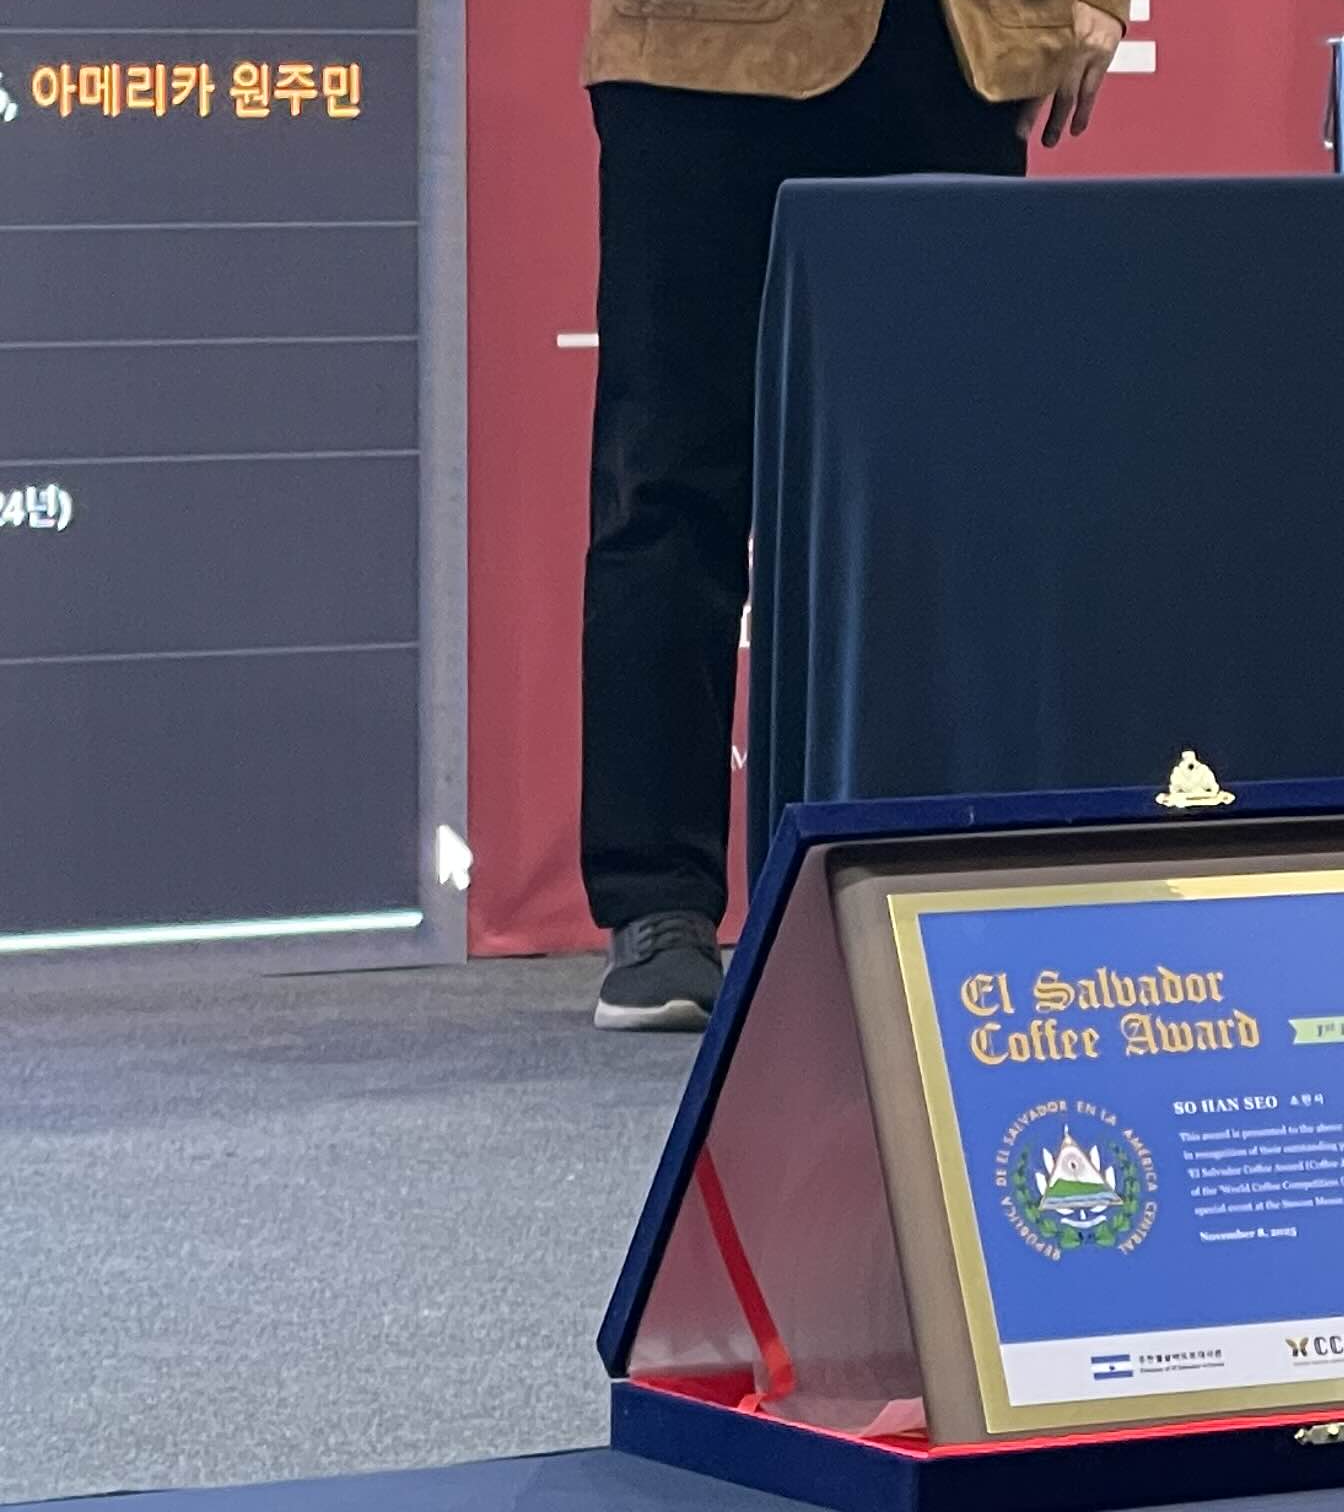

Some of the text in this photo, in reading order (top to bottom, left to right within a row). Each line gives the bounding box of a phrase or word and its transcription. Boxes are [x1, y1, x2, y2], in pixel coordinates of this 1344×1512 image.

[31, 61, 215, 118] 아메리카
[231, 61, 362, 121] 원주민
[961, 964, 1225, 1016] El Salvador
[970, 1009, 1261, 1065] Coffee Award
[1173, 1101, 1197, 1115] SO
[1201, 1098, 1240, 1113] HAN
[1244, 1095, 1278, 1111] SEO
[1200, 1228, 1255, 1241] November
